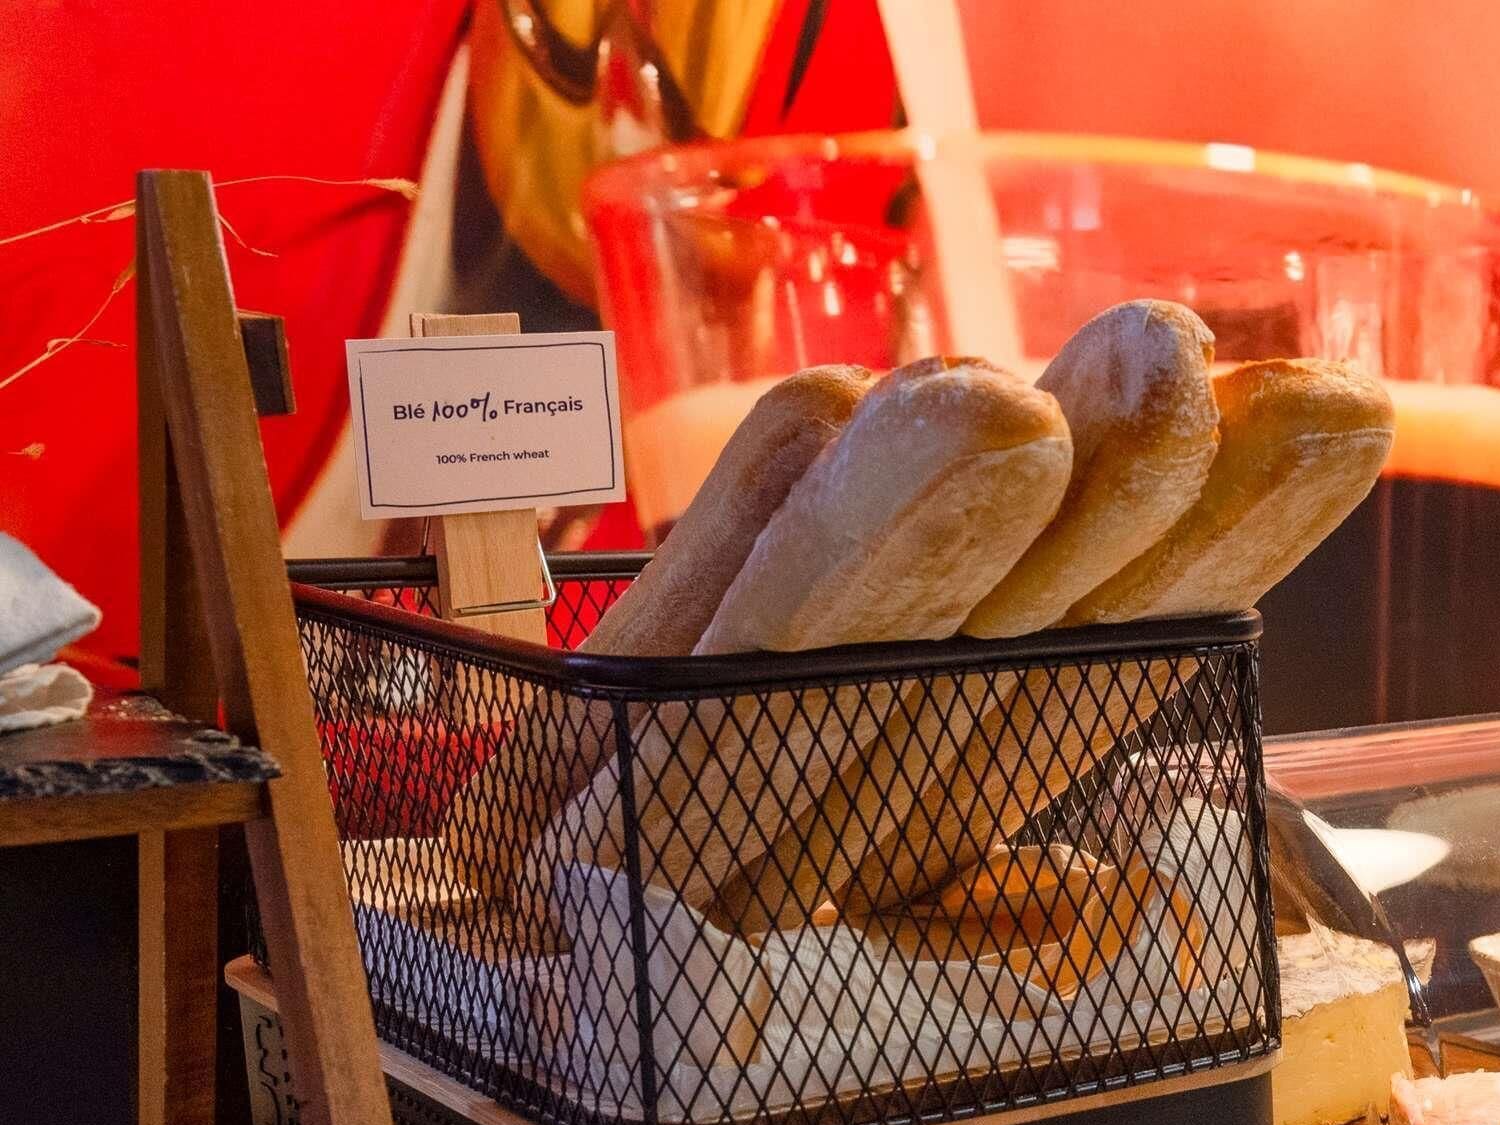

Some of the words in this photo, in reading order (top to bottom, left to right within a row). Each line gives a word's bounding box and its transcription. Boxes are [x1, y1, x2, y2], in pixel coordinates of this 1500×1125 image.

[393, 403, 425, 420] Blé
[432, 391, 498, 422] 100%
[504, 396, 584, 417] Français
[436, 453, 467, 465] 100%
[469, 451, 510, 463] French
[512, 449, 551, 461] wheat
